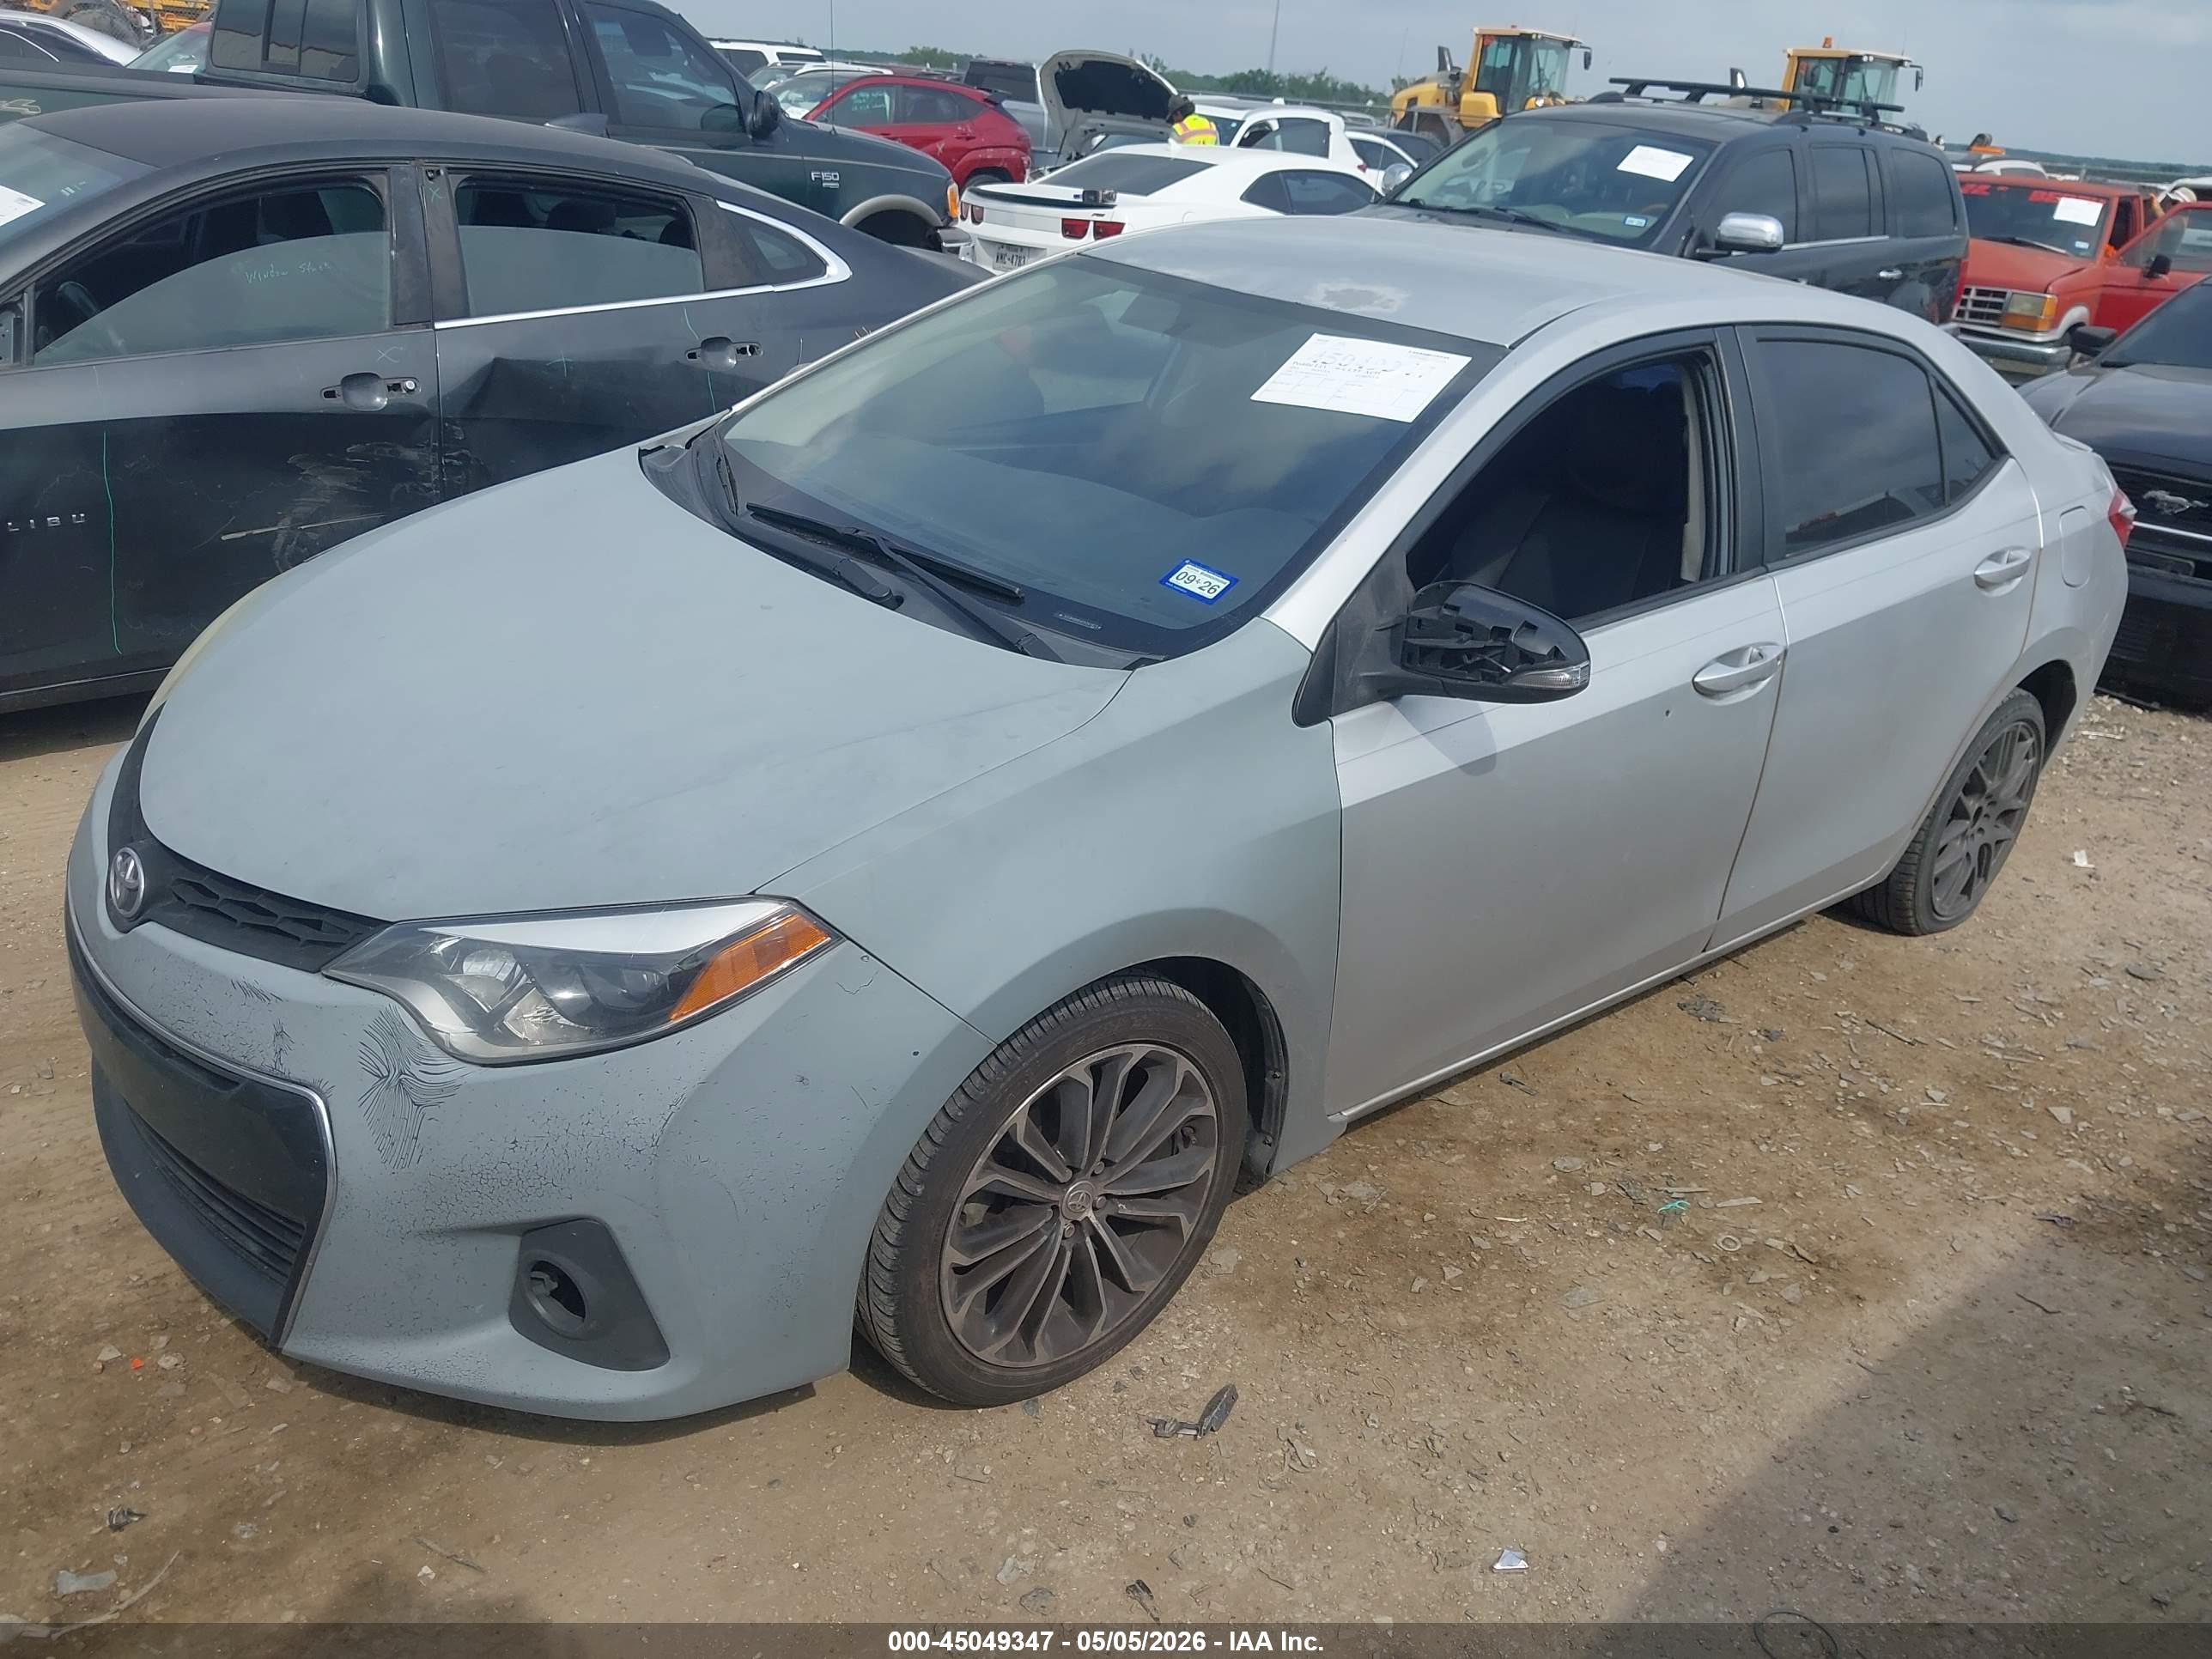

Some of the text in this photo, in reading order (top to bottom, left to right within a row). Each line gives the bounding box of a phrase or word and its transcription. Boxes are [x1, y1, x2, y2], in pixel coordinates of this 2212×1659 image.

[811, 172, 839, 181] F150
[1176, 571, 1196, 585] 09
[1198, 580, 1220, 594] 26
